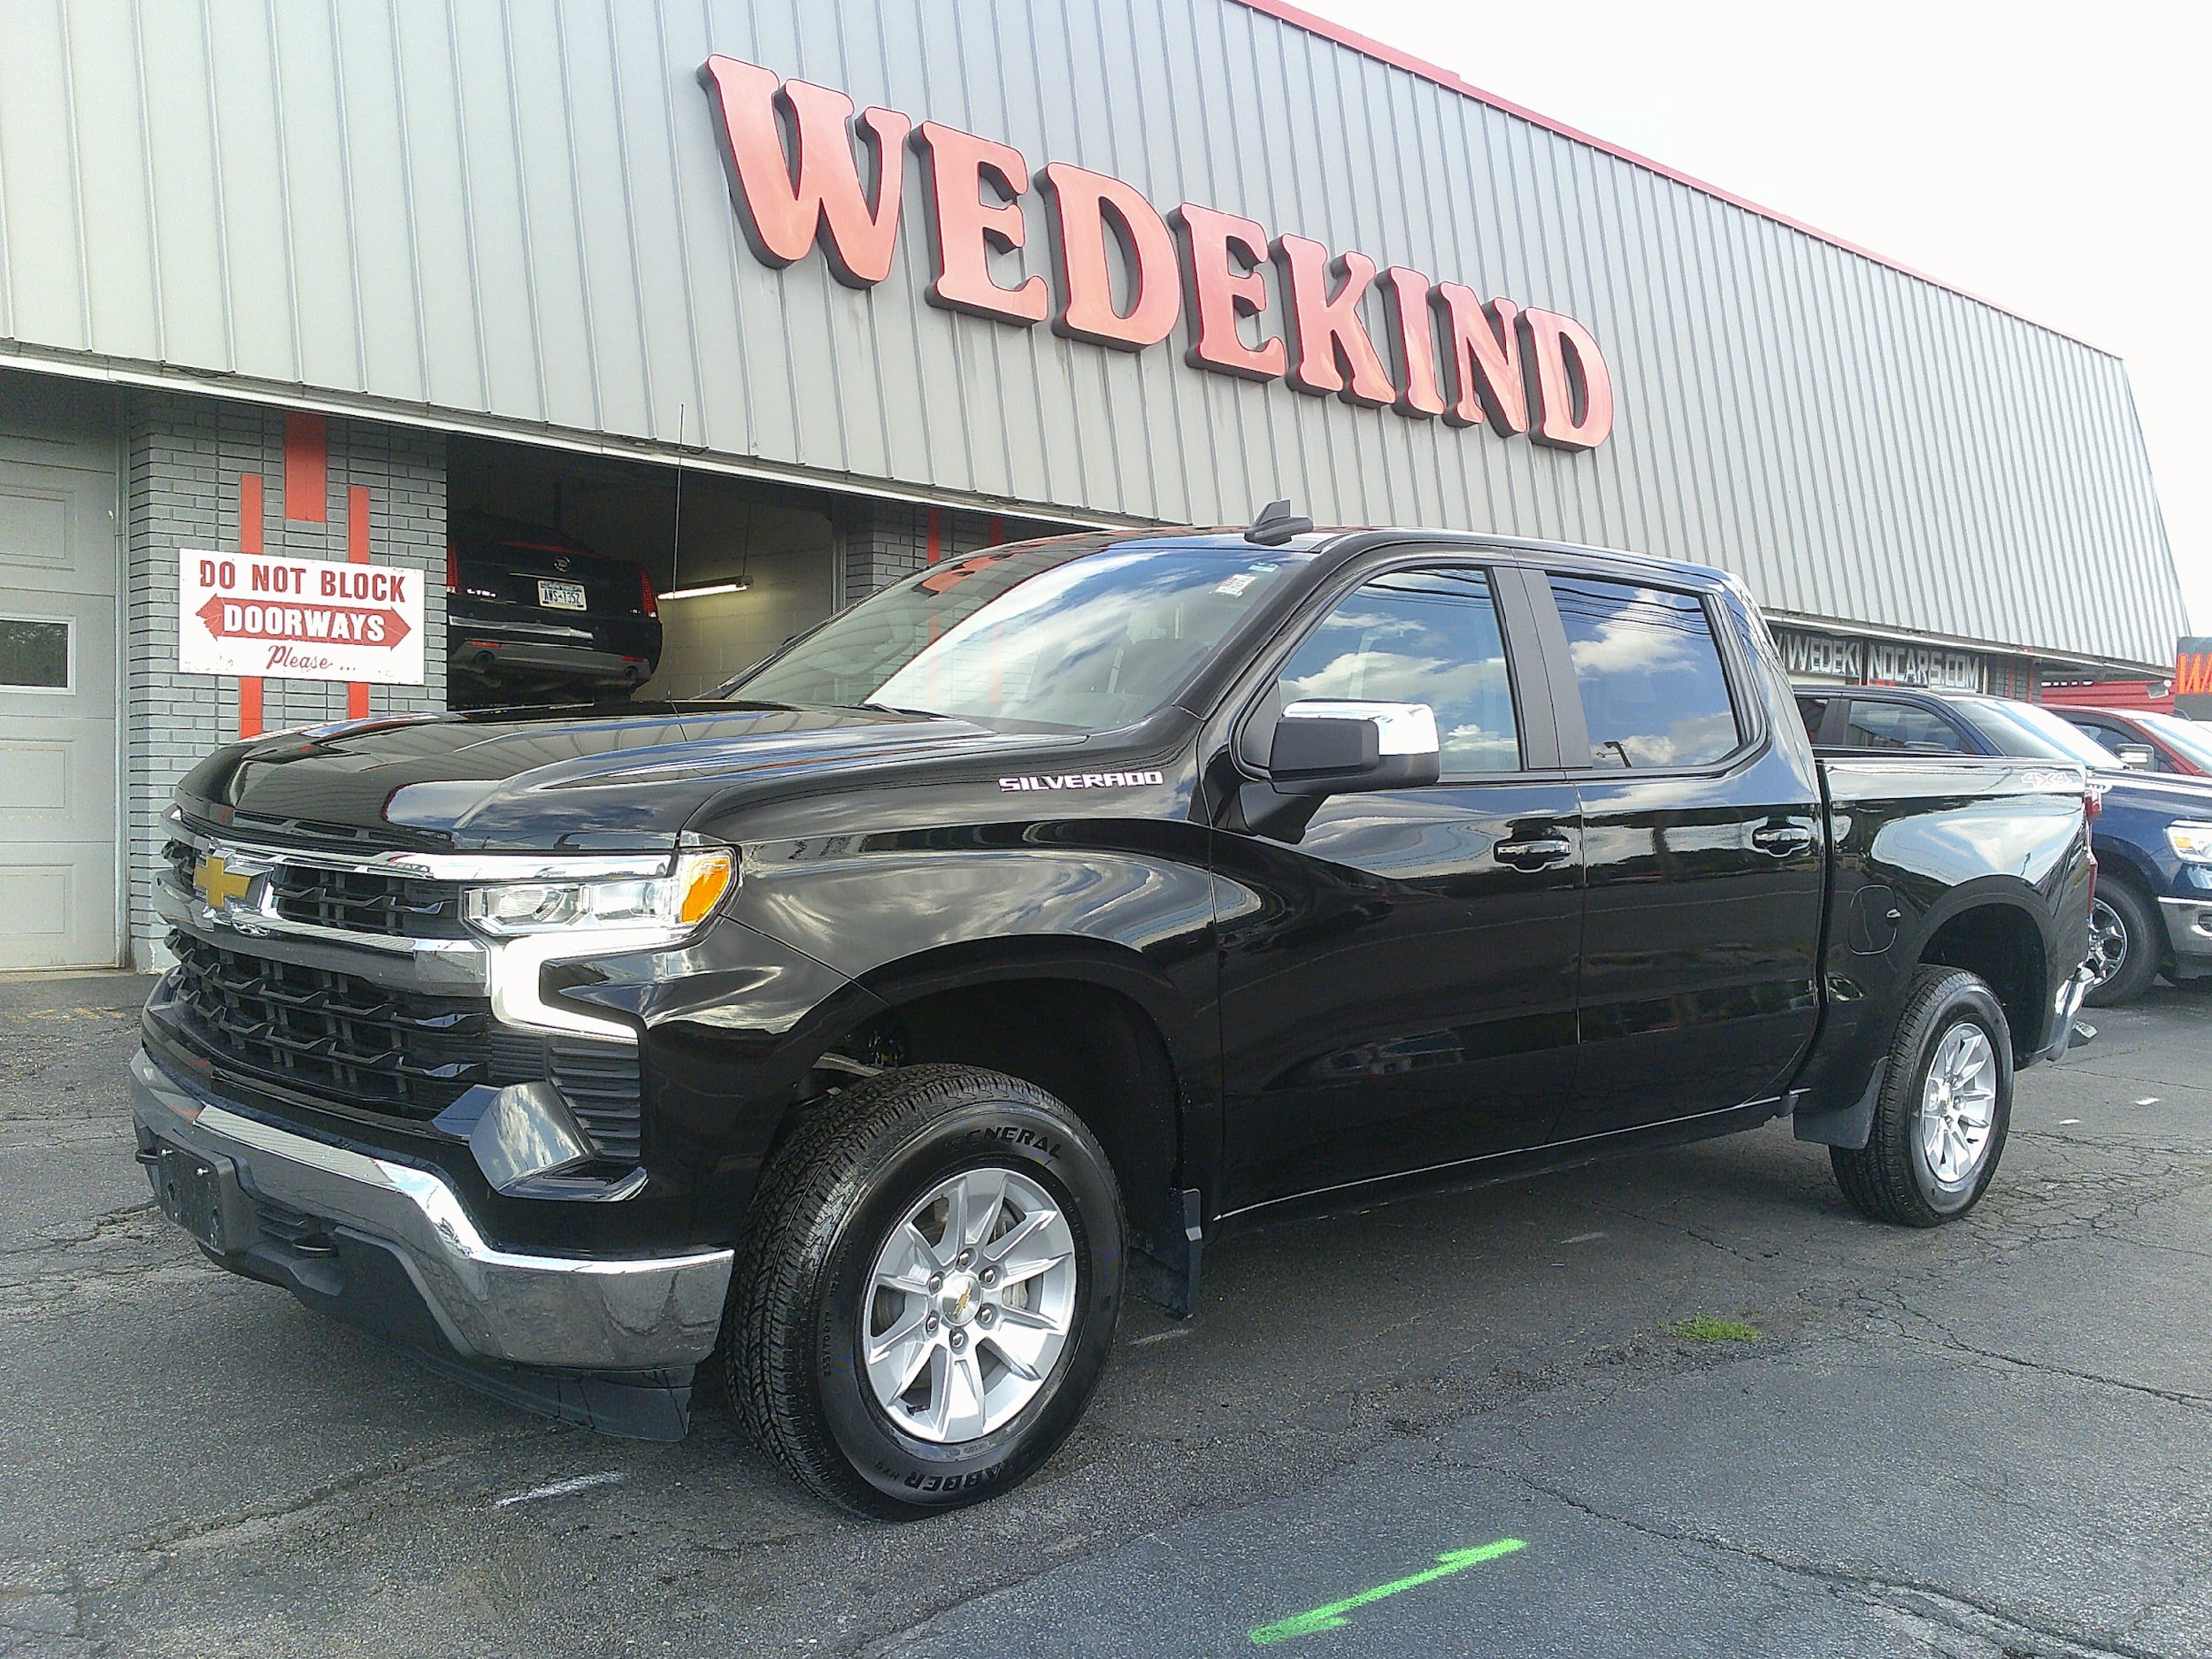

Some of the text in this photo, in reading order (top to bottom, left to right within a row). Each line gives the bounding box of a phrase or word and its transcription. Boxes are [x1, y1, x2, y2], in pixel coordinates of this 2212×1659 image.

[699, 53, 1616, 452] WEDEKIND
[200, 559, 405, 603] DO NOT BLOCK
[223, 603, 386, 642] DOORWAYS
[999, 771, 1164, 792] SILVERADO
[945, 1126, 1063, 1159] GENERAL
